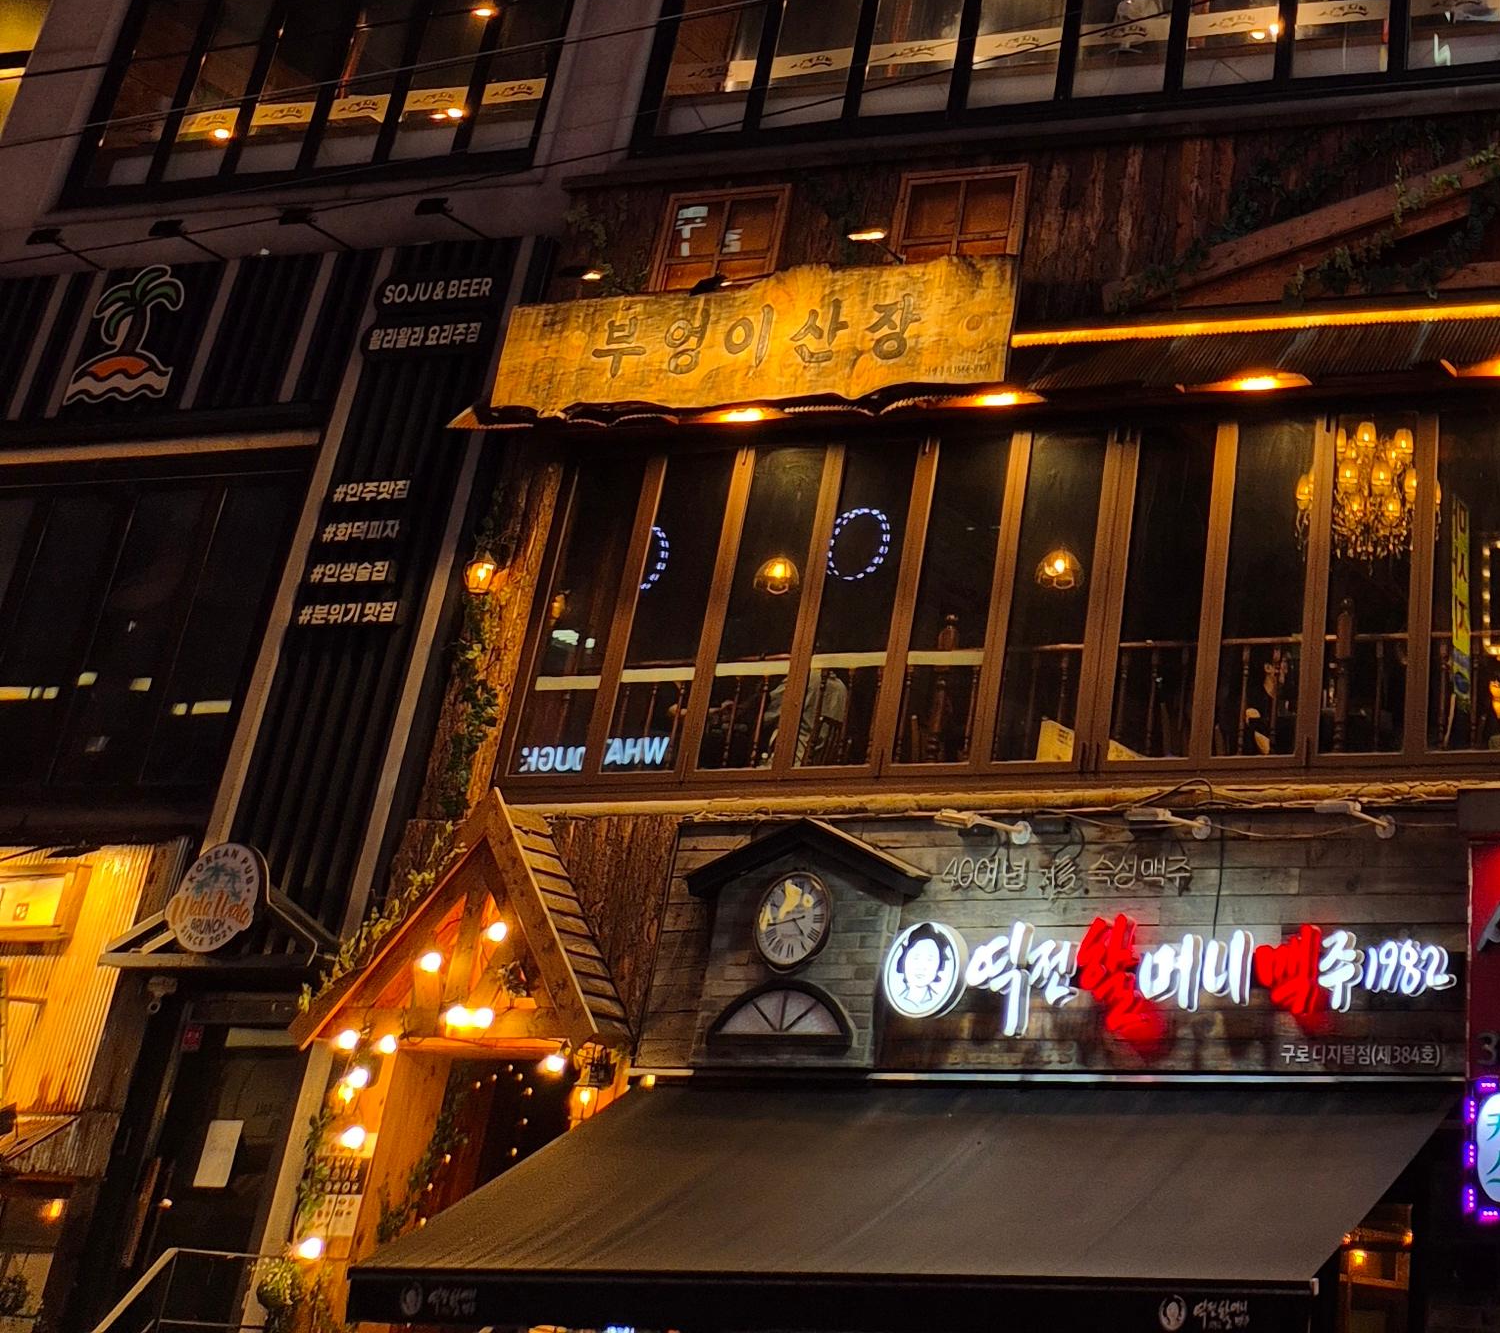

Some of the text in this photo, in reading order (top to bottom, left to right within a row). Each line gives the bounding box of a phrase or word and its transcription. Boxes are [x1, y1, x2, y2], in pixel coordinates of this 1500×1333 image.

[591, 293, 923, 379] 부엉이산장
[333, 480, 410, 502] #안주맛집
[322, 519, 400, 543] #화덕피자
[310, 561, 389, 583] #인생술집
[298, 601, 398, 625] #분위기 맛집
